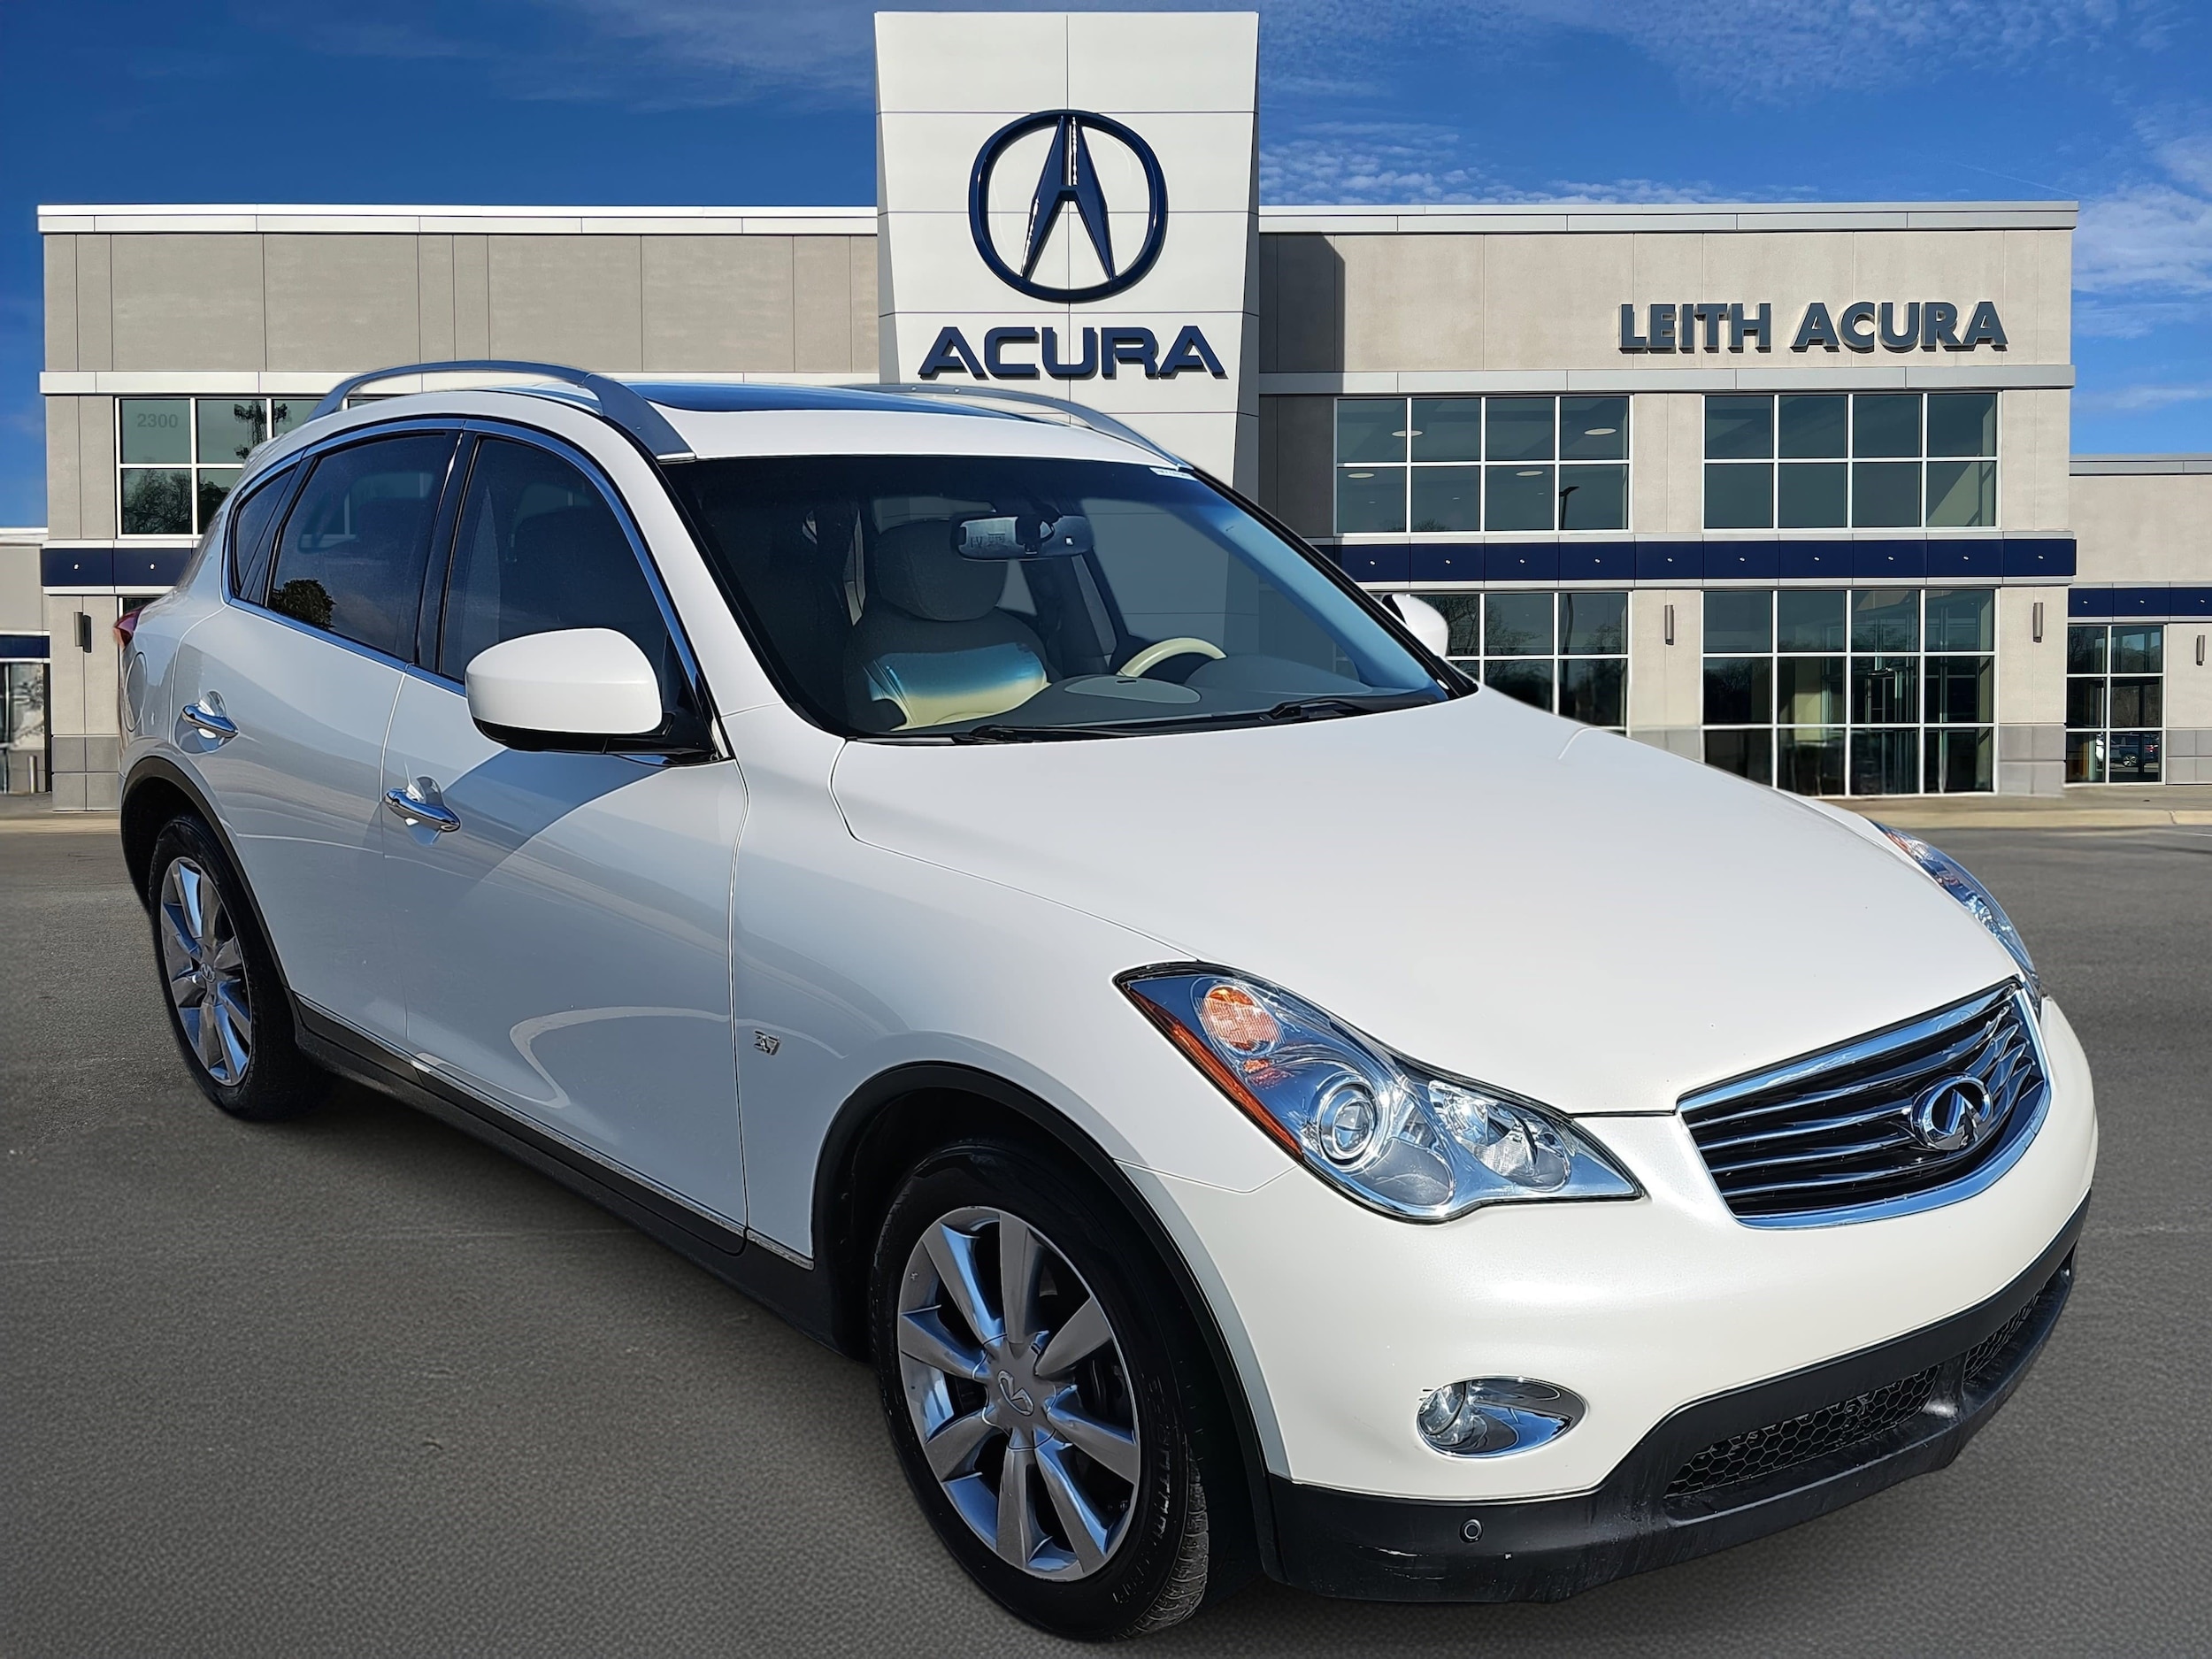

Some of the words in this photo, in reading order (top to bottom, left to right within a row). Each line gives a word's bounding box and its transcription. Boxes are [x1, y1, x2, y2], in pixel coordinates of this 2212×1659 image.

[918, 326, 1228, 380] ACURA
[1618, 303, 1771, 354] LEITH
[1790, 301, 2008, 353] ACURA
[137, 413, 179, 428] 2300
